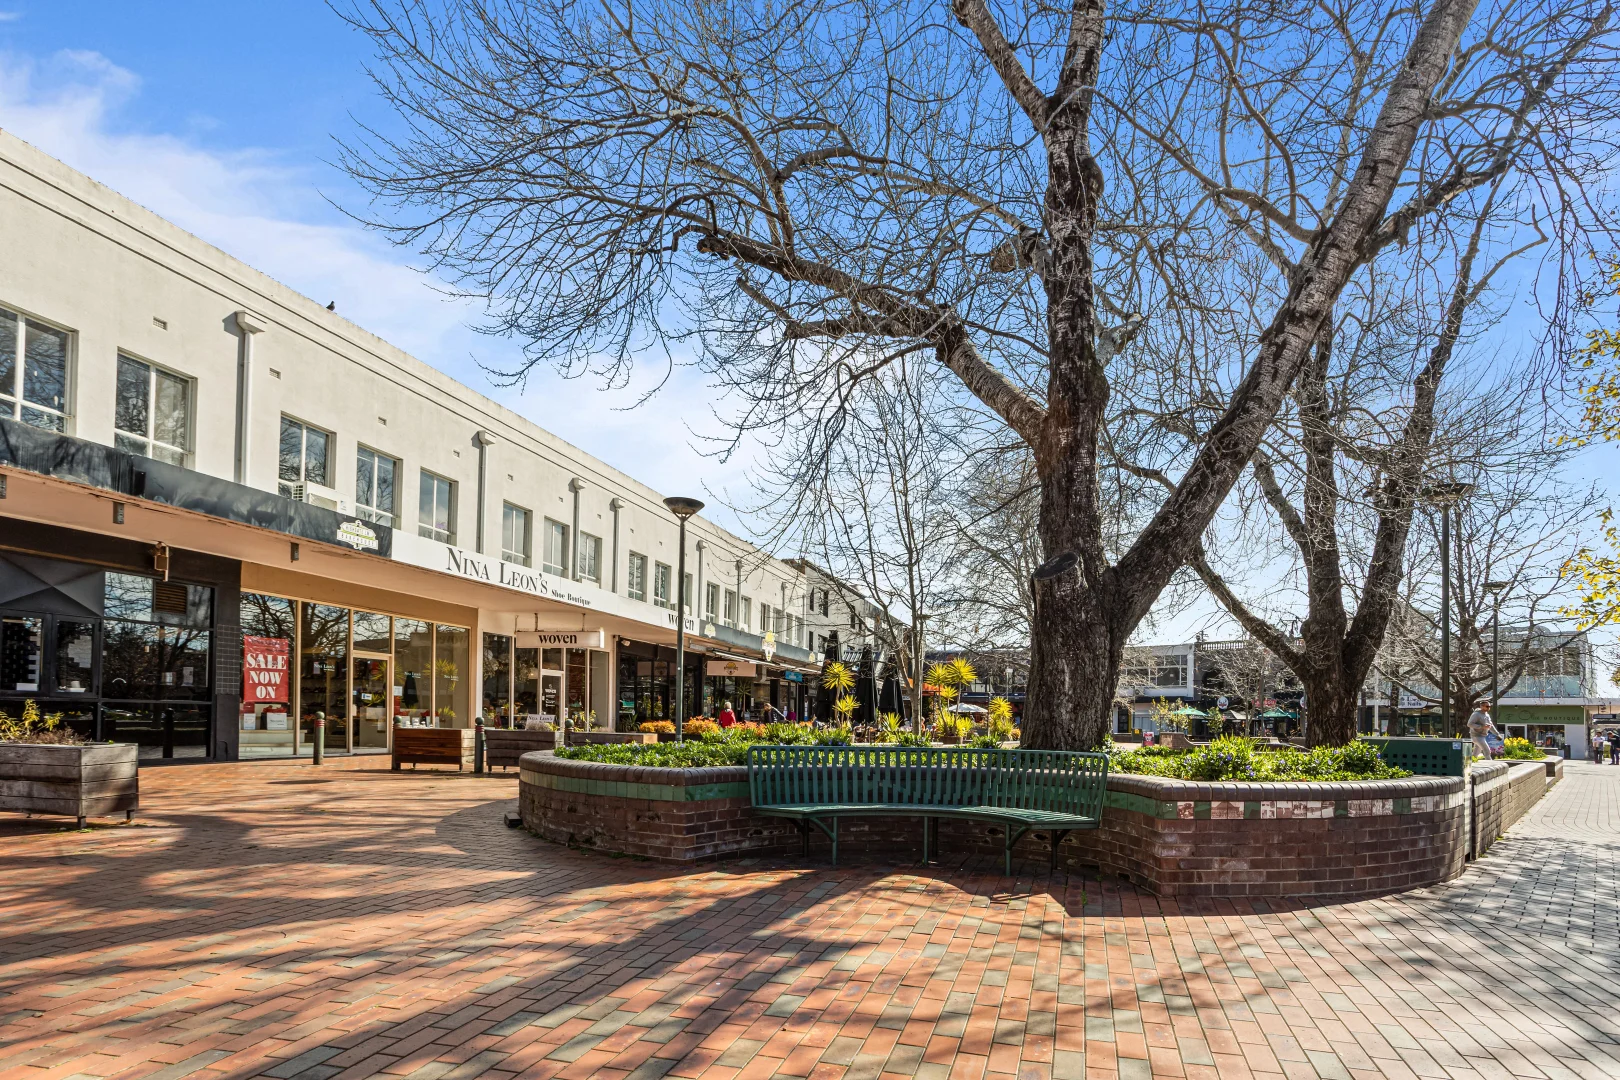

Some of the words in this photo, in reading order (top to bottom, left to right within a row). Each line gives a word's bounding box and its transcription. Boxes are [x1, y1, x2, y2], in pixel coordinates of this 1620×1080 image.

[446, 547, 490, 580] NINA
[499, 562, 548, 594] LEON'S
[551, 589, 566, 599] Shoe
[567, 593, 591, 606] Boutique
[538, 634, 578, 644] woven
[246, 652, 287, 670] SALE
[249, 670, 283, 685] NOW
[255, 685, 276, 699] ON
